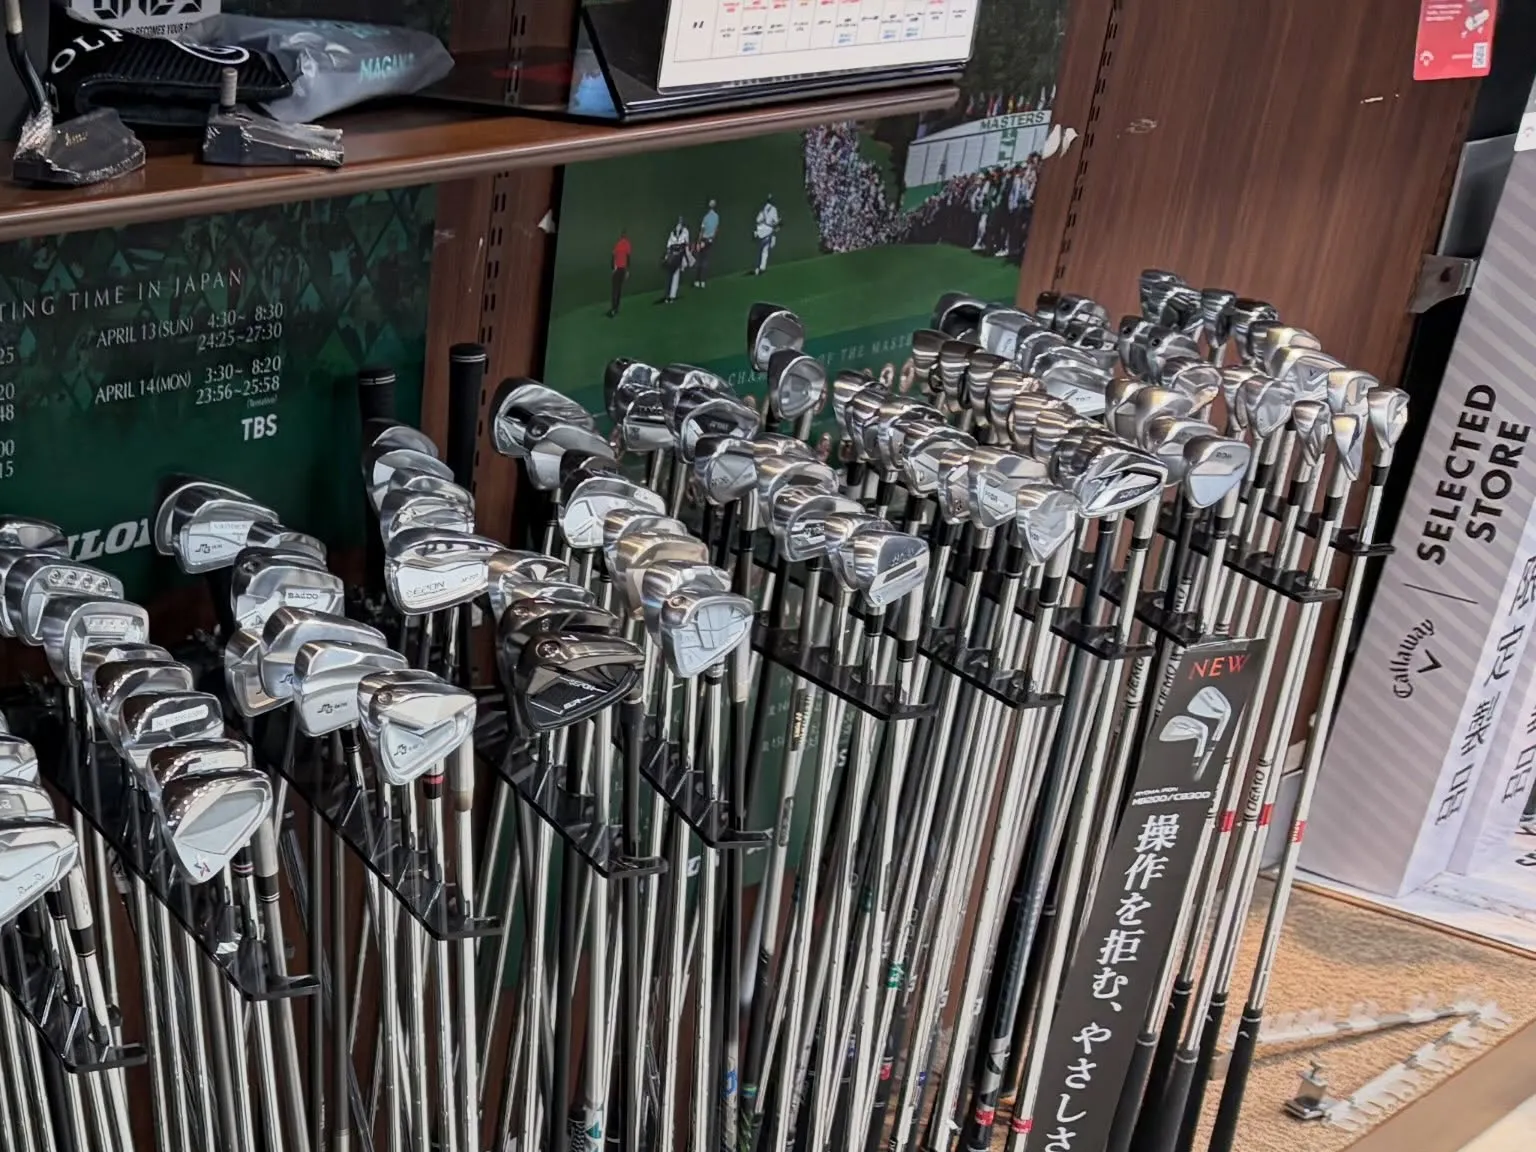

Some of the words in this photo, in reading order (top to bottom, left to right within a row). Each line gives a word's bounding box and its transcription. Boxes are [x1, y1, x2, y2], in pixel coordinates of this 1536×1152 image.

[979, 111, 1046, 130] MASTERS
[69, 285, 125, 311] TIME
[138, 280, 162, 300] IN
[175, 269, 243, 297] JAPAN
[96, 326, 137, 348] APRIL
[254, 302, 284, 321] 8:30
[95, 382, 135, 404] APRIL
[251, 356, 281, 375] 8:20
[241, 413, 278, 441] TBS
[1416, 384, 1497, 566] SELECTED
[1465, 420, 1531, 543] STORE
[1188, 653, 1251, 681] NEW
[1389, 618, 1435, 699] Callaway
